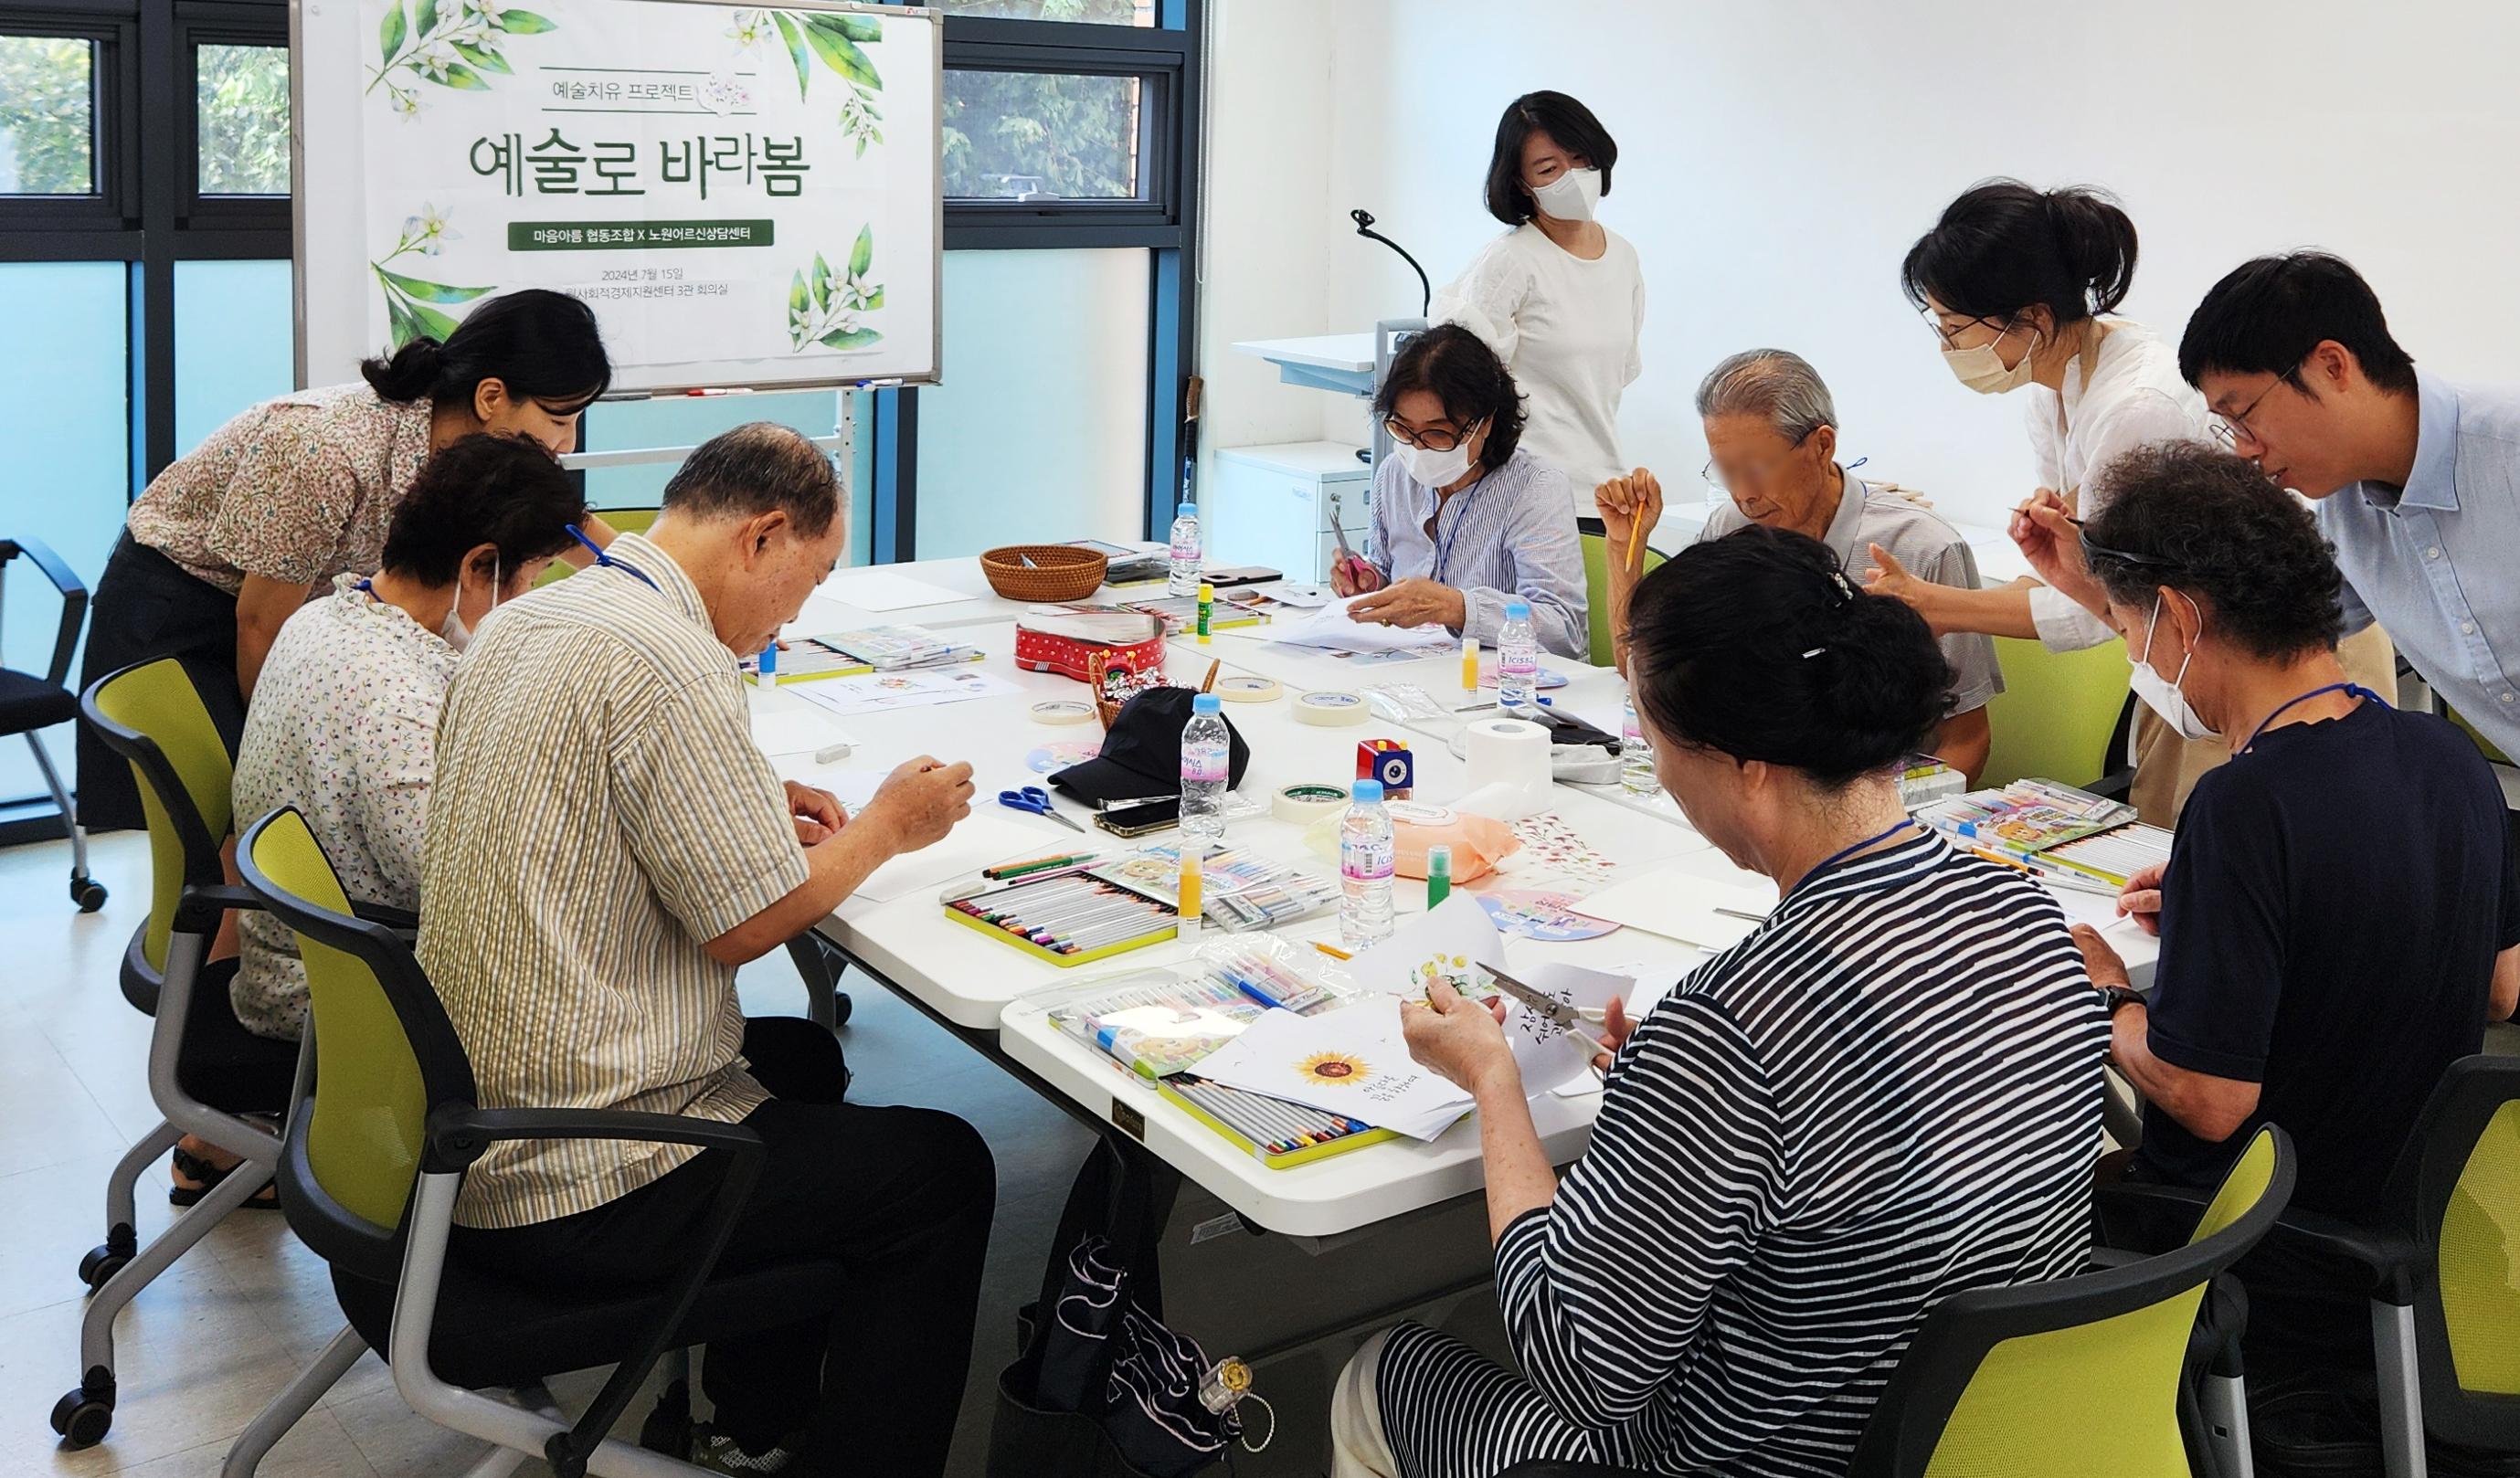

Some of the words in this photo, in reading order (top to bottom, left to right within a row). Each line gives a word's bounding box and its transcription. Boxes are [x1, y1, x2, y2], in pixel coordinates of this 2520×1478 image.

[553, 80, 622, 100] 예술치유
[627, 83, 694, 101] 프로젝트
[470, 127, 646, 197] 예술로
[659, 132, 811, 201] 바라봄
[534, 228, 583, 243] 마음아름
[587, 227, 634, 243] 협동조합
[637, 229, 645, 241] X
[649, 227, 751, 241] 노원어르신상담센터
[601, 269, 639, 281] 2024년
[641, 268, 658, 281] 7월
[661, 267, 684, 280] 15일
[677, 284, 694, 297] 3관
[697, 283, 729, 296] 회의실
